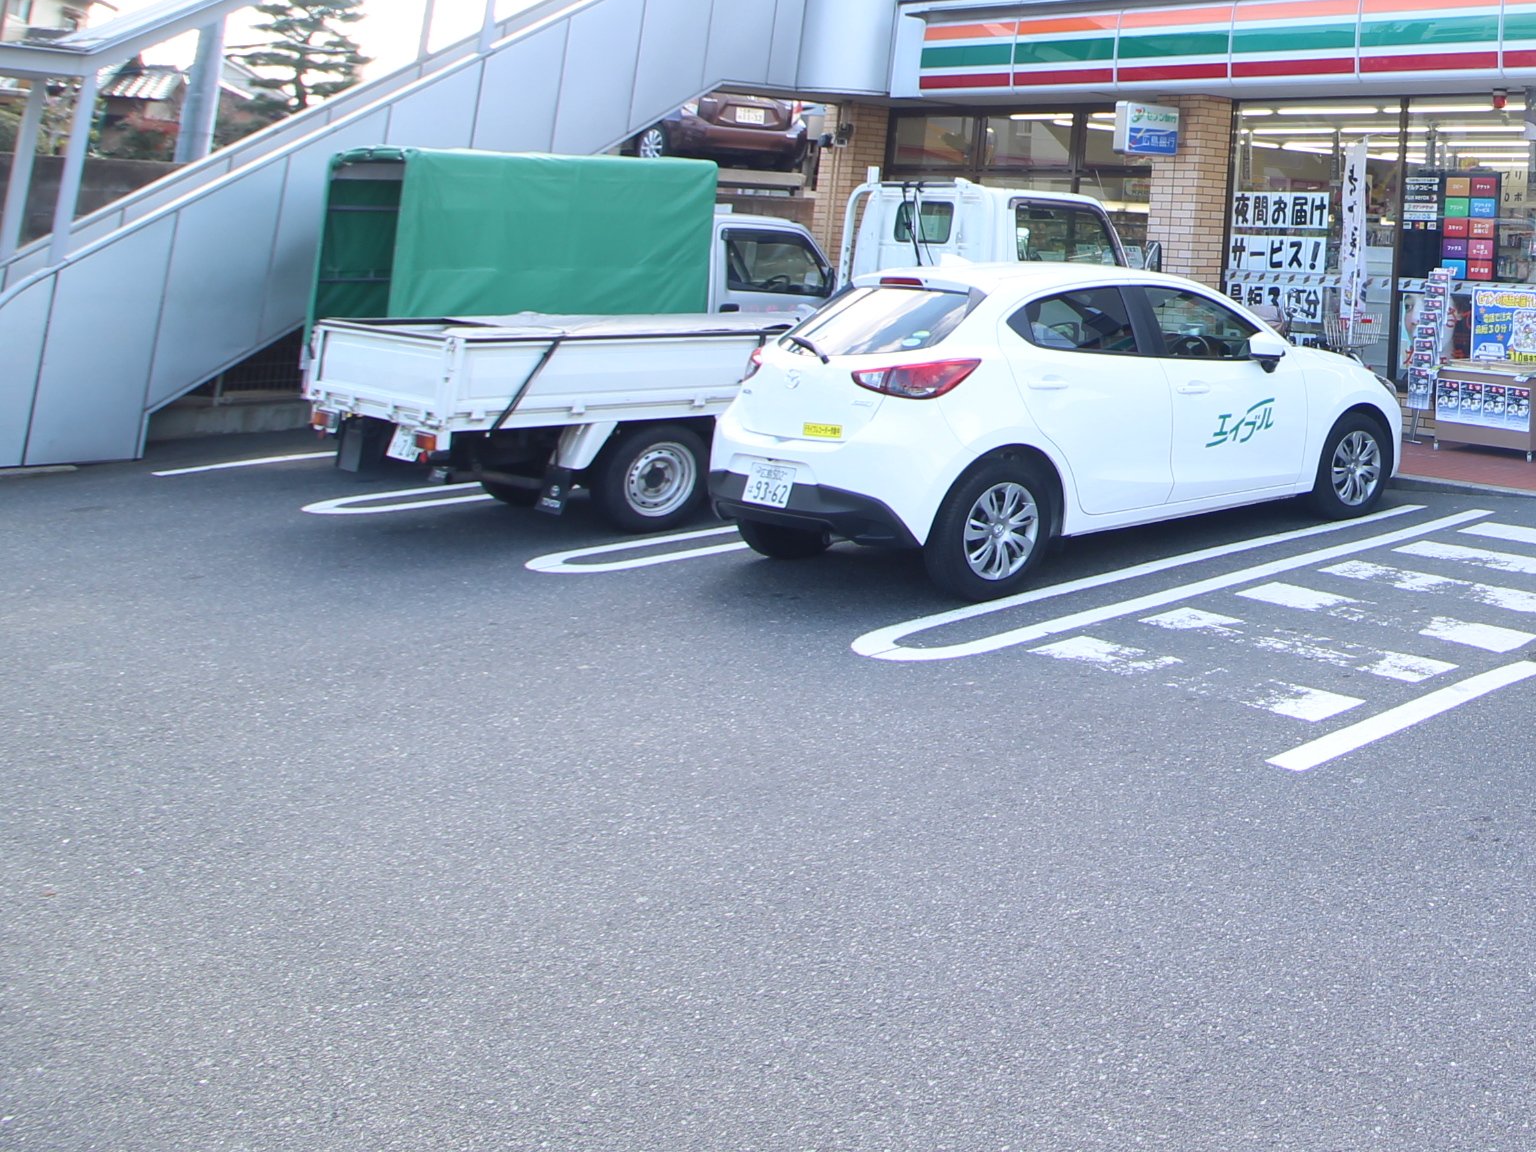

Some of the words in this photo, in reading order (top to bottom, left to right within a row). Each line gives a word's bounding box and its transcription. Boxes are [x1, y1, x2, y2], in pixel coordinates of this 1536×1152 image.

[1234, 194, 1327, 226] 夜間お届け
[1205, 397, 1275, 448] エイブル
[753, 480, 788, 504] 93-62
